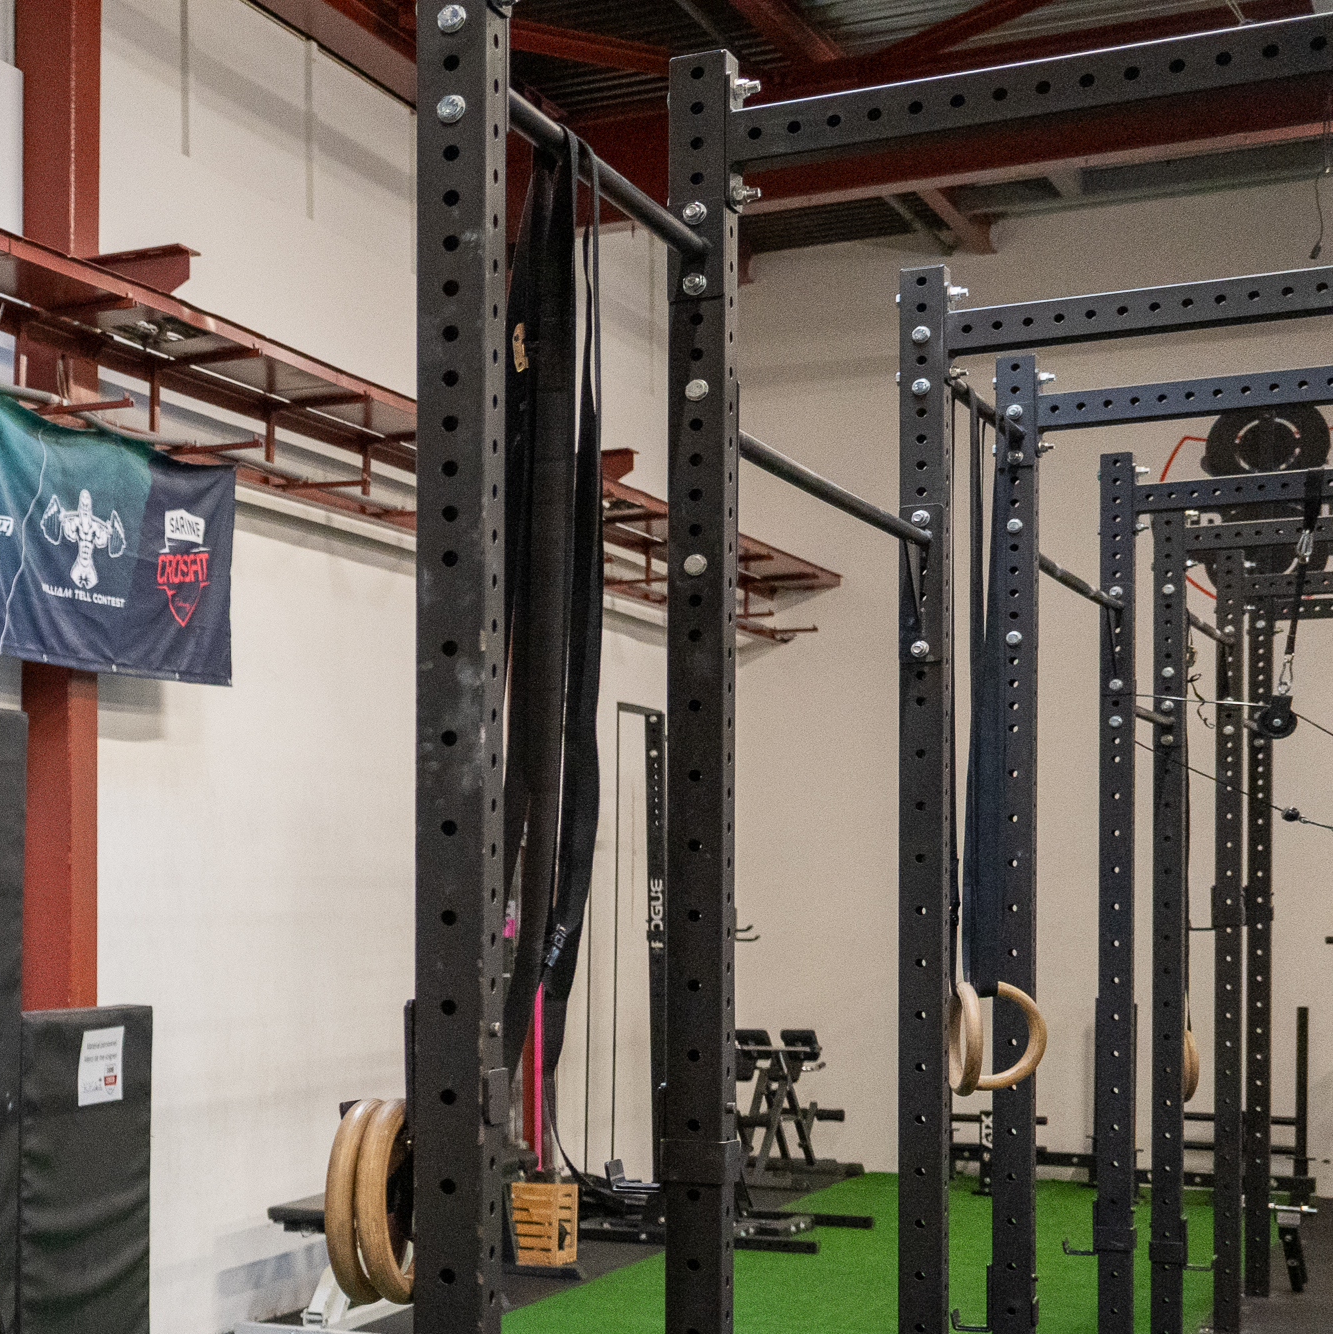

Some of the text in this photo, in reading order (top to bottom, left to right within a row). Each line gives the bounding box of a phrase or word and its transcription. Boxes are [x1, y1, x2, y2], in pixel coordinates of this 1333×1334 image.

[169, 516, 201, 538] SARINE
[74, 588, 93, 603] TELL
[93, 592, 126, 609] CONTEST
